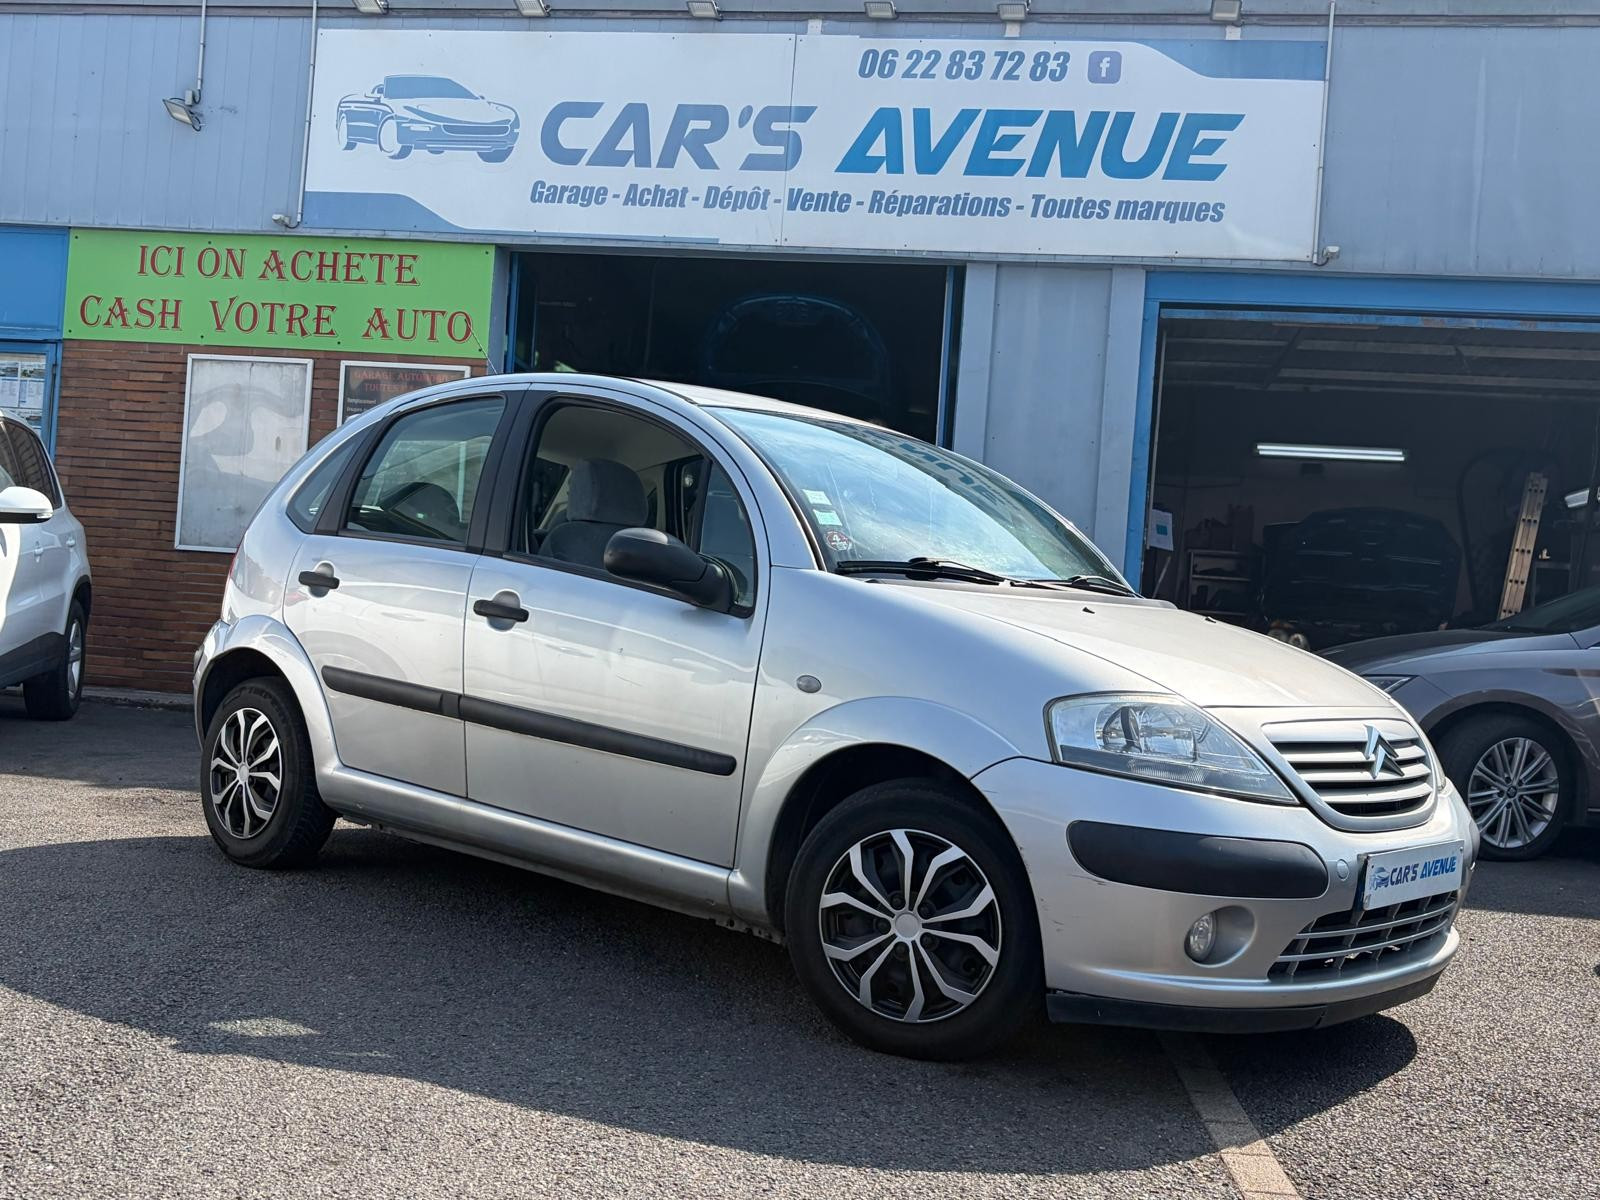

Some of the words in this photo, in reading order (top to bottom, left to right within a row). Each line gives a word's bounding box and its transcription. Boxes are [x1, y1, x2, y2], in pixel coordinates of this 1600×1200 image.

[858, 48, 898, 79] 06
[901, 49, 942, 80] 22
[945, 50, 986, 80] 83
[990, 50, 1026, 81] 72
[1029, 51, 1071, 82] 83
[540, 101, 818, 172] CAR'S
[834, 107, 1246, 181] AVENUE
[530, 180, 609, 208] Garage
[622, 183, 690, 208] Achat
[703, 185, 771, 212] Dépôt
[786, 187, 852, 213] Vente
[868, 189, 1013, 218] Réparations
[1030, 193, 1112, 220] Toutes
[1114, 199, 1226, 224] marques
[137, 245, 185, 278] ICI
[197, 247, 247, 280] ON
[258, 249, 421, 287] ACHETE
[79, 295, 183, 331] CASH
[209, 295, 339, 338] VOTRE
[361, 307, 473, 344] AUTO
[1390, 864, 1419, 886] CAR'S
[1420, 856, 1457, 879] AVENUE
